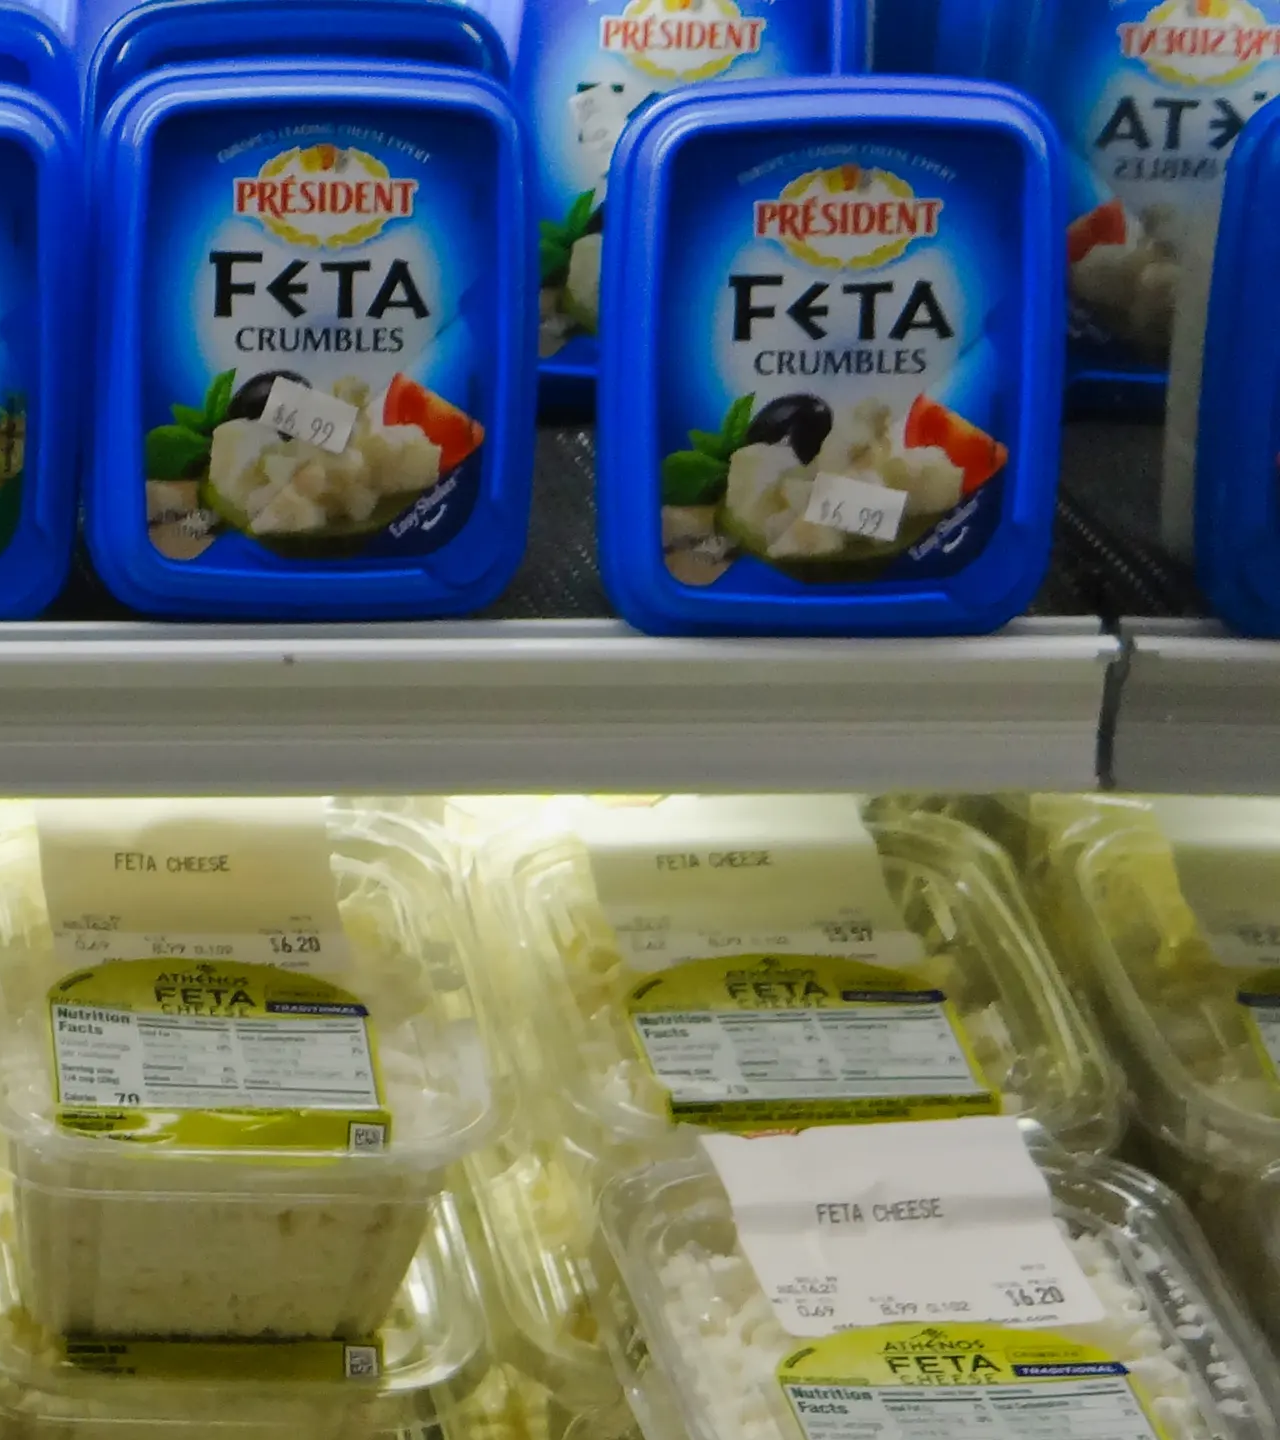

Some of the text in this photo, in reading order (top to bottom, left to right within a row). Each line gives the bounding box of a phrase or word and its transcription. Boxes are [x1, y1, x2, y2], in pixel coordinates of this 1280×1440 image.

[603, 12, 762, 54] PRÉSIDENT
[235, 175, 417, 219] PRÉSIDENT
[755, 195, 939, 239] PRÉSIDENT
[208, 251, 430, 319] FETA
[728, 274, 955, 340] FETA
[234, 326, 405, 353] CRUMBLES
[753, 348, 928, 377] CRUMBLES
[114, 853, 229, 874] FETA CHEESE
[656, 850, 772, 871] FETA CHEESE
[816, 1199, 944, 1224] FETA CHEESE
